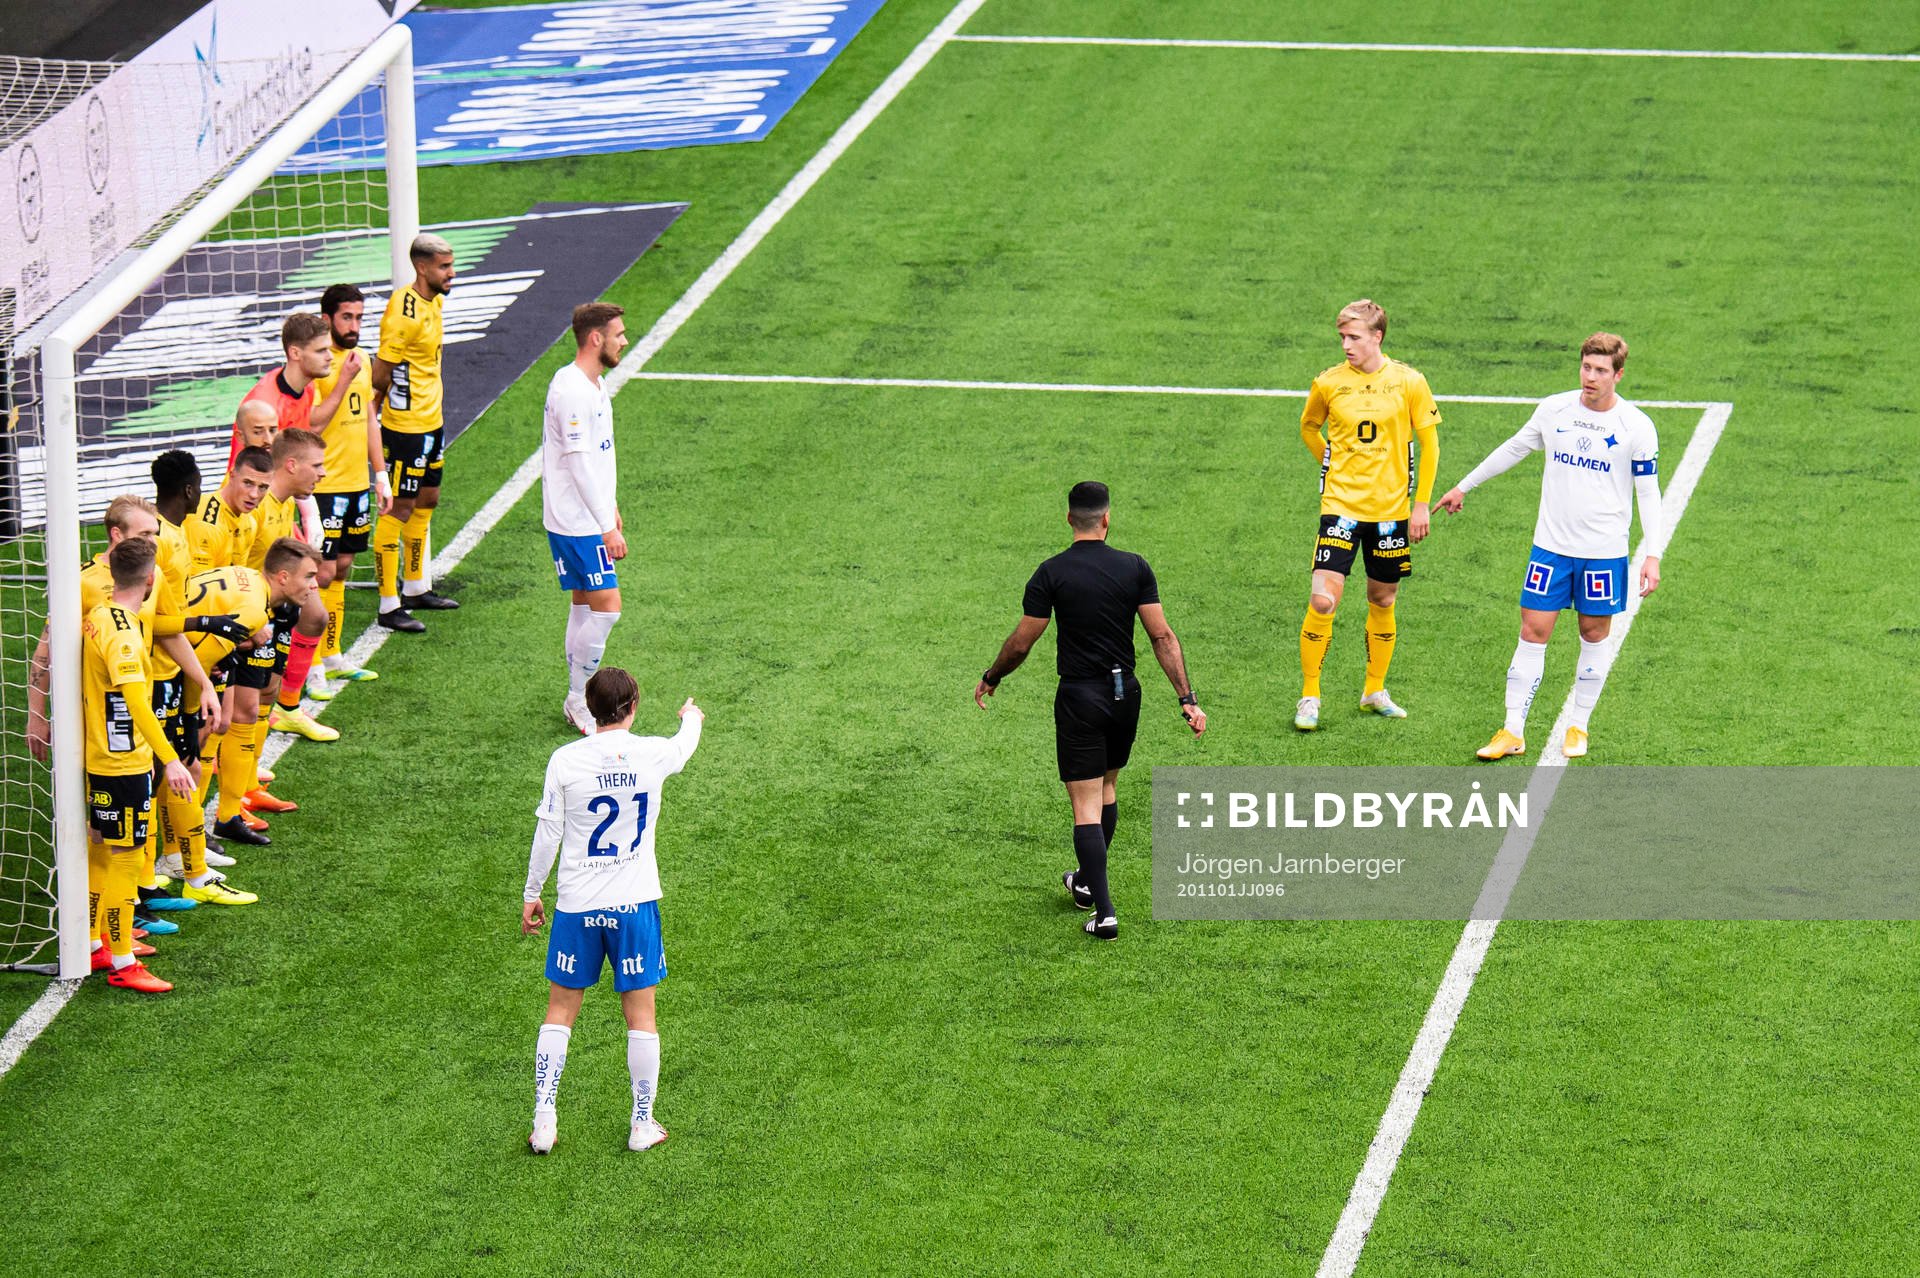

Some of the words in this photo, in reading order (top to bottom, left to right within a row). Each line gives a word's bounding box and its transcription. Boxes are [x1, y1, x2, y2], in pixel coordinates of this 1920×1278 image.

[1573, 420, 1606, 433] stadium
[1553, 450, 1611, 473] HOLMEN
[1327, 526, 1352, 540] ellos
[1378, 536, 1405, 549] ellos
[587, 572, 603, 586] 18
[595, 772, 637, 790] THERN
[587, 791, 648, 857] 21
[583, 914, 619, 930] RÖR
[556, 951, 577, 974] nt
[622, 953, 645, 975] nt
